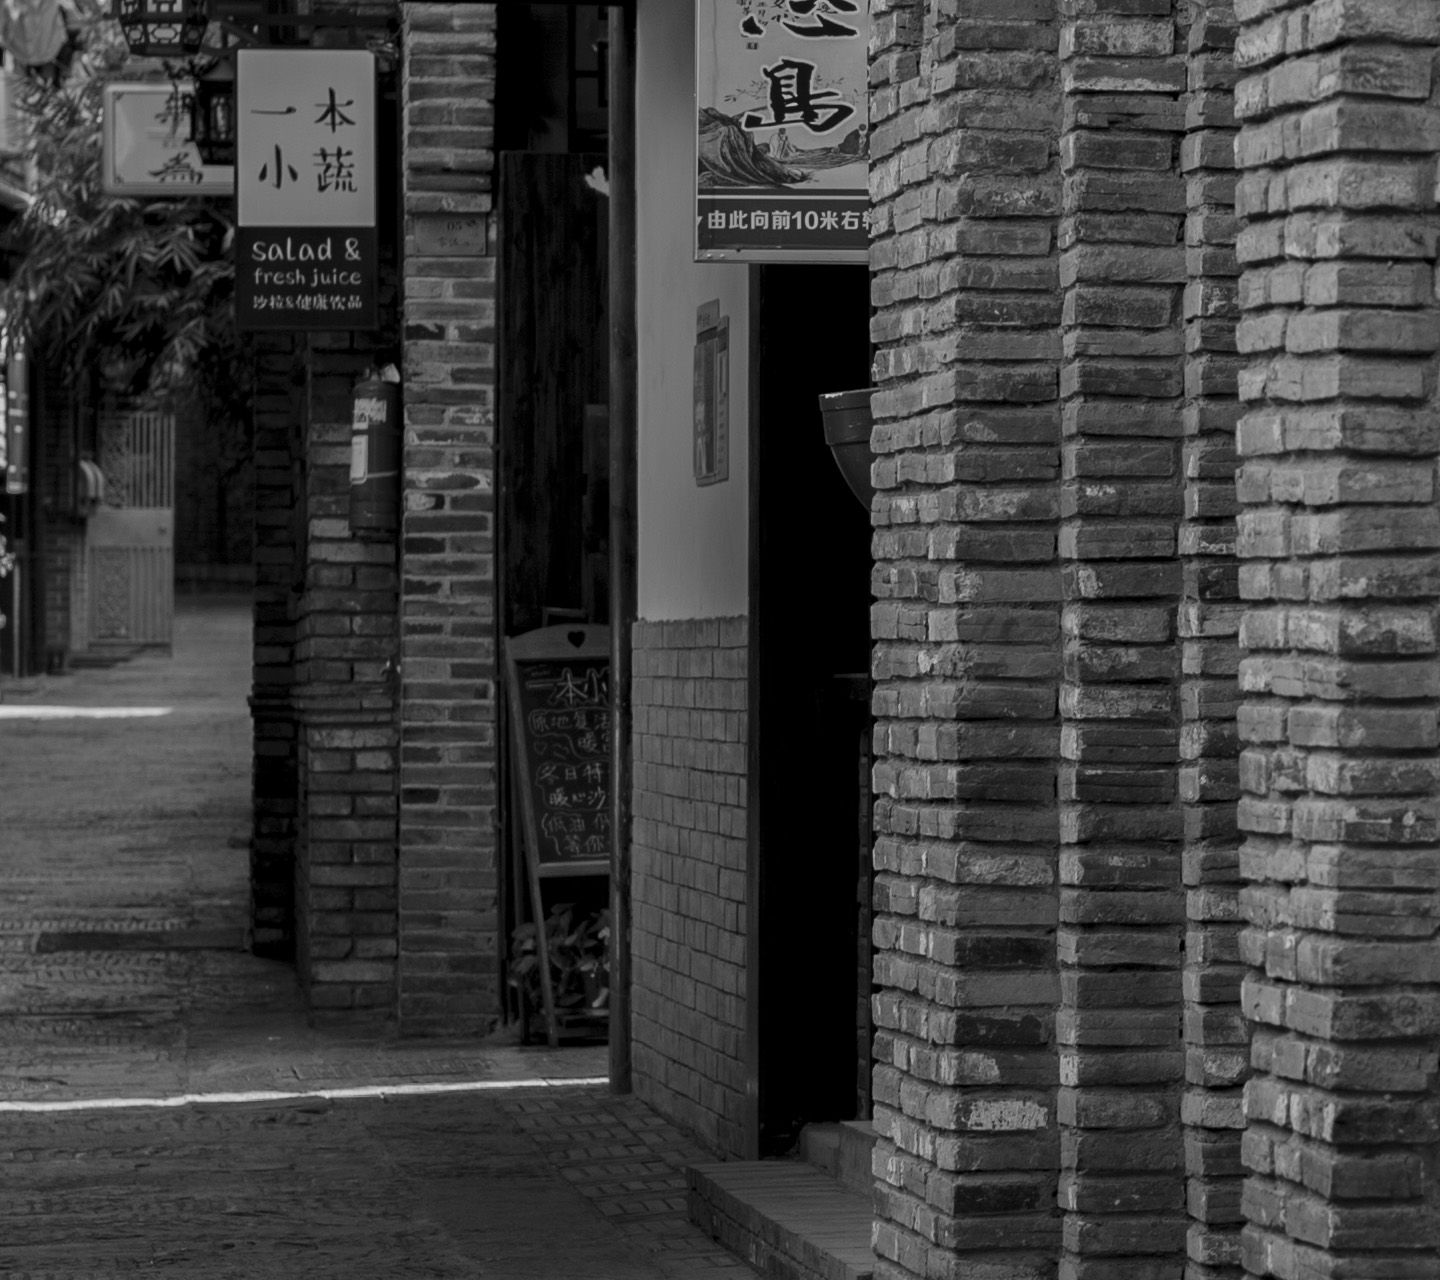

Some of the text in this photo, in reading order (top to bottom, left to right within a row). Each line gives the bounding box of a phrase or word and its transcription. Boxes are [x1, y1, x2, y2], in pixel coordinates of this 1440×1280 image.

[251, 237, 362, 262] salad &
[253, 267, 362, 287] fresh juice
